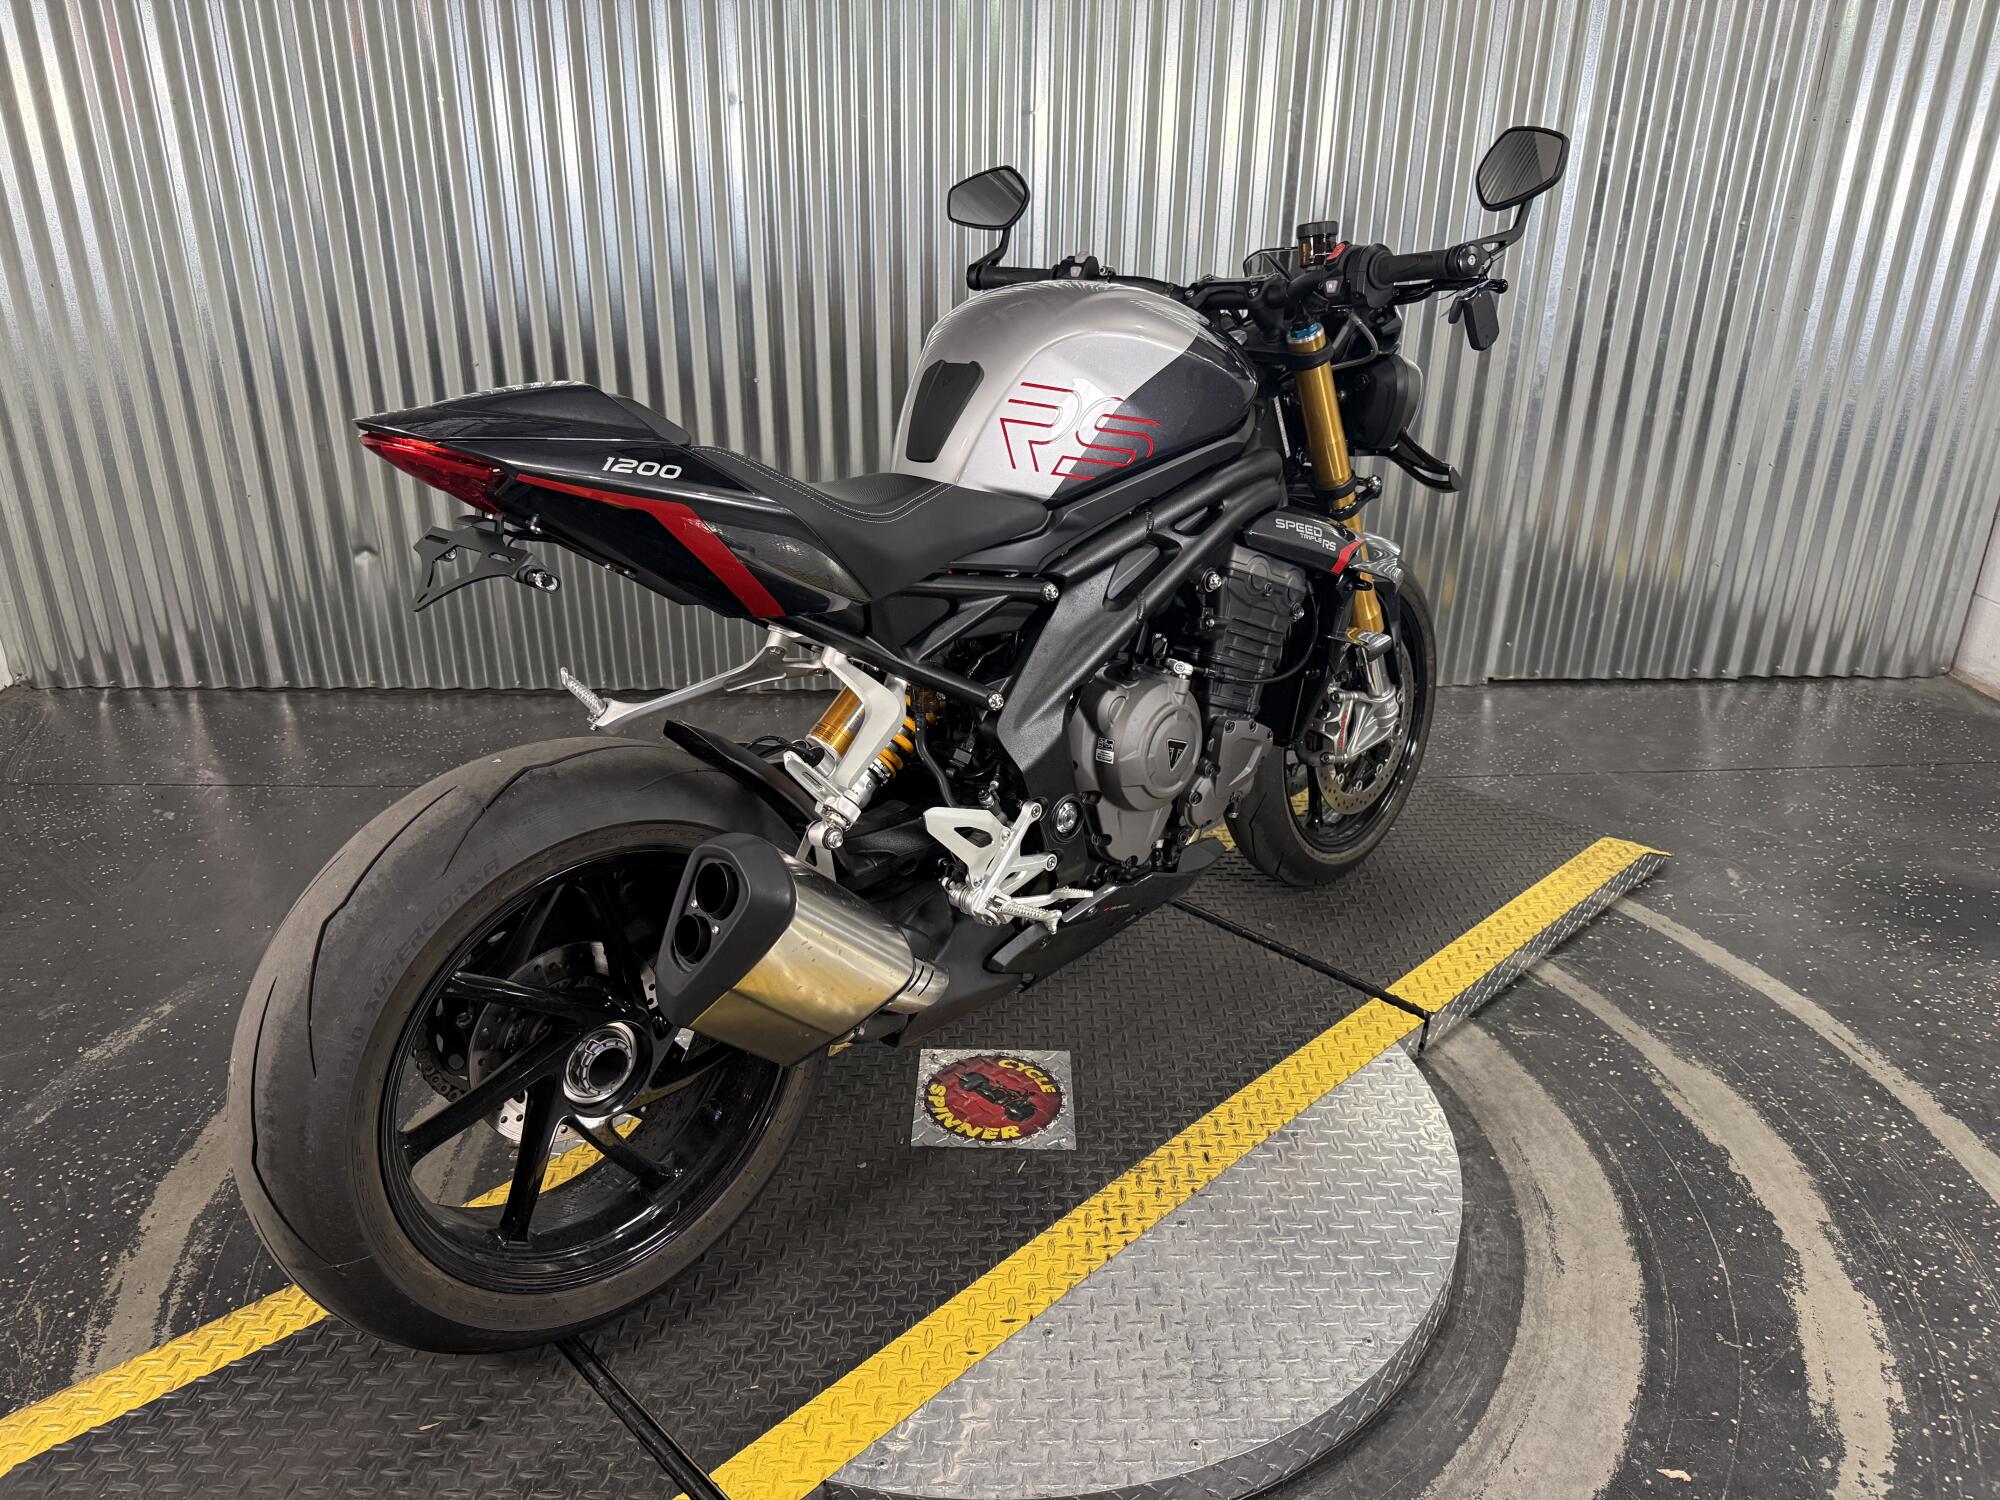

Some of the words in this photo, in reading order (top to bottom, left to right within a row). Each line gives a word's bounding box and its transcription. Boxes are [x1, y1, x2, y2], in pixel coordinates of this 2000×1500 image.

[1000, 381, 1162, 480] RS
[602, 456, 682, 480] 1200
[1275, 519, 1322, 537] SPEED
[1299, 532, 1322, 544] TRIPLE
[1322, 538, 1337, 552] RS
[998, 1058, 1057, 1094] CYCLE
[927, 1083, 1021, 1140] SPINNER
